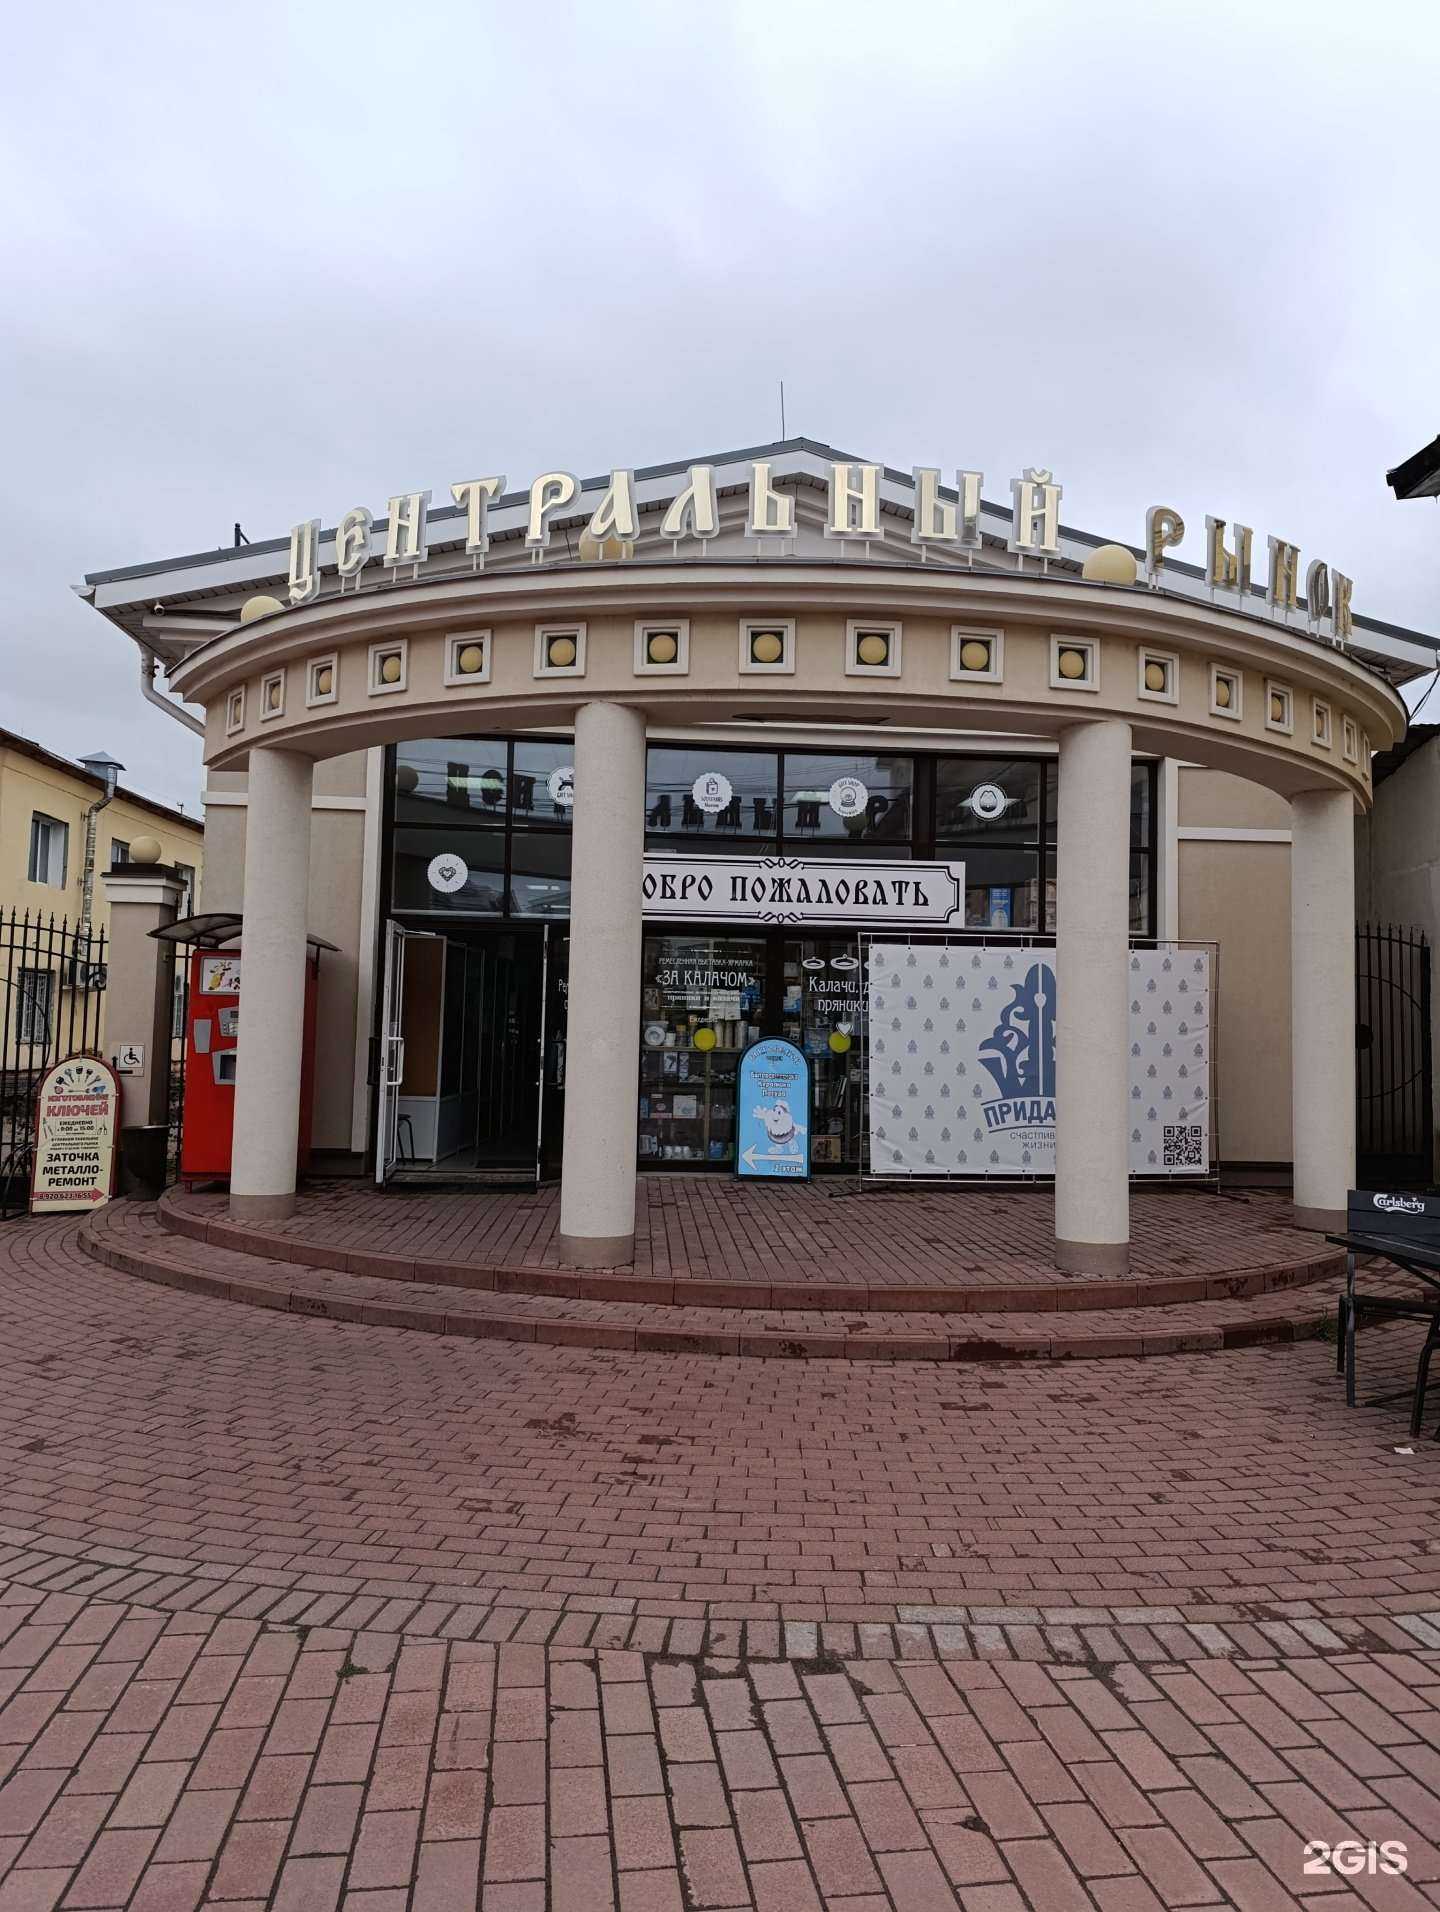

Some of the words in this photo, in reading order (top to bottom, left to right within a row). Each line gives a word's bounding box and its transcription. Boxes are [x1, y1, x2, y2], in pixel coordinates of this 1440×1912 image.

[288, 462, 1061, 603] ЦЕНТРАЛЬНЫЙ
[1145, 506, 1353, 641] РЫНОК
[729, 875, 930, 907] ПОЖАЛОВАТЬ
[46, 1101, 109, 1117] КЛЮЧЕЙ
[46, 1152, 100, 1162] ЗАТОЧКА
[42, 1164, 104, 1175] МЕТАЛЛО-
[48, 1176, 97, 1187] РЕМОНТ
[1373, 1193, 1425, 1214] Carlsberg
